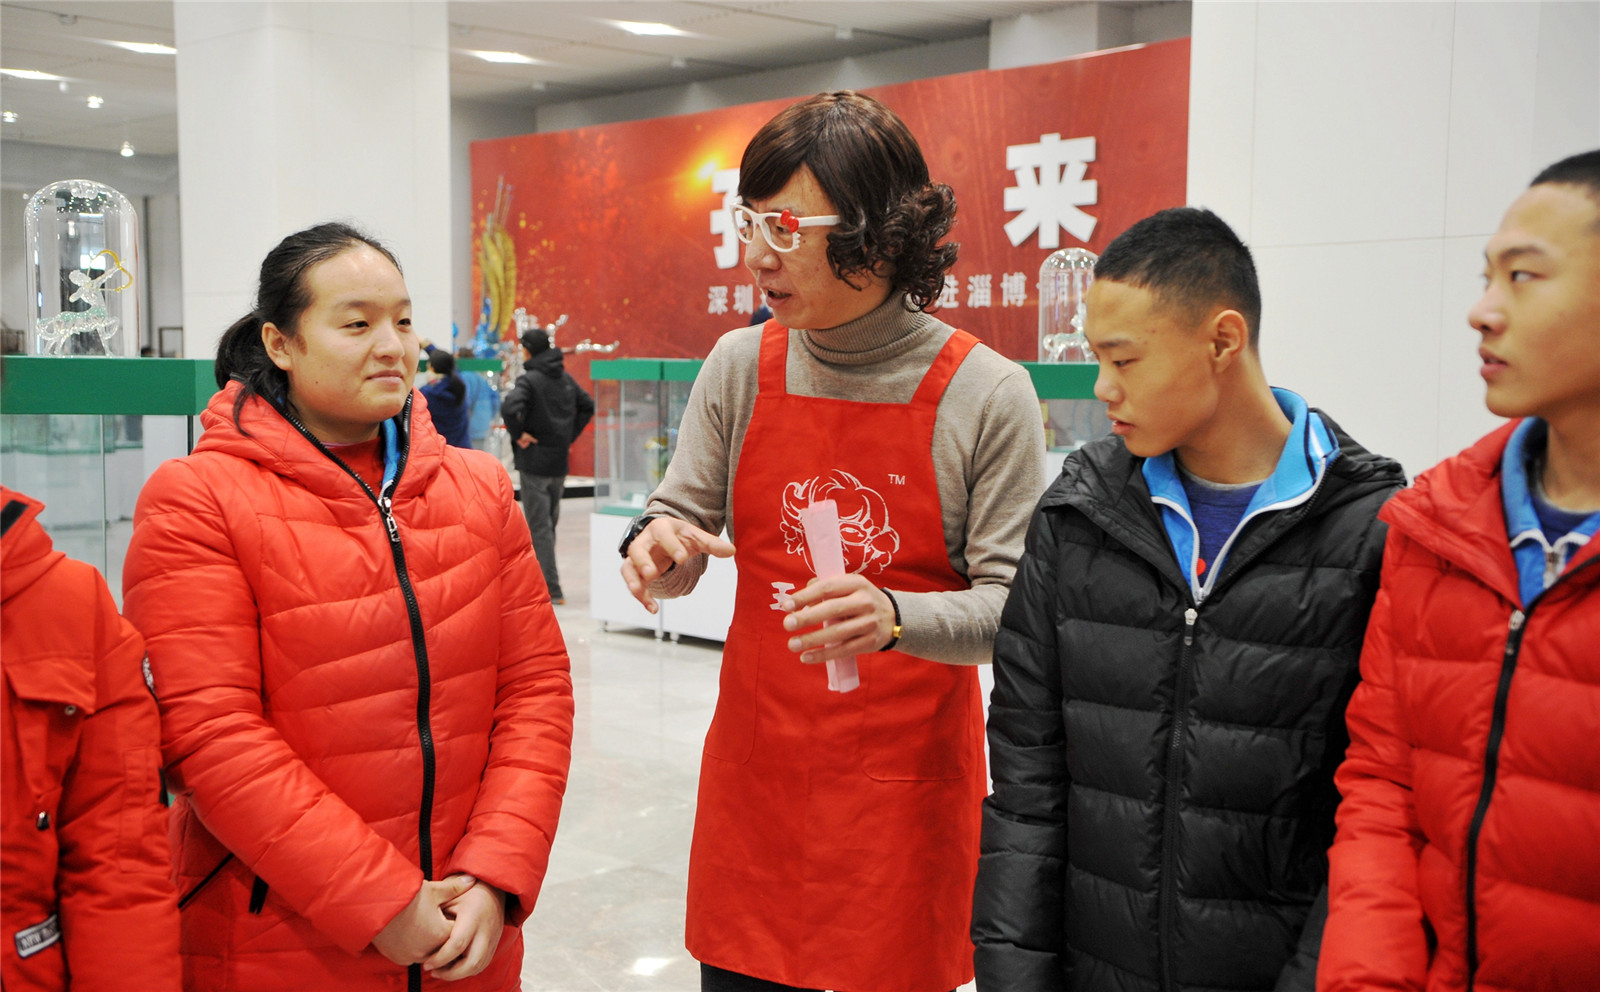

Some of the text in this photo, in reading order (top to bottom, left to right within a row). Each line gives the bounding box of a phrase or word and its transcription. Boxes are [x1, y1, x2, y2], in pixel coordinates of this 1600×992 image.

[1004, 133, 1098, 249] 来
[707, 284, 753, 315] 深圳
[888, 473, 906, 485] TM
